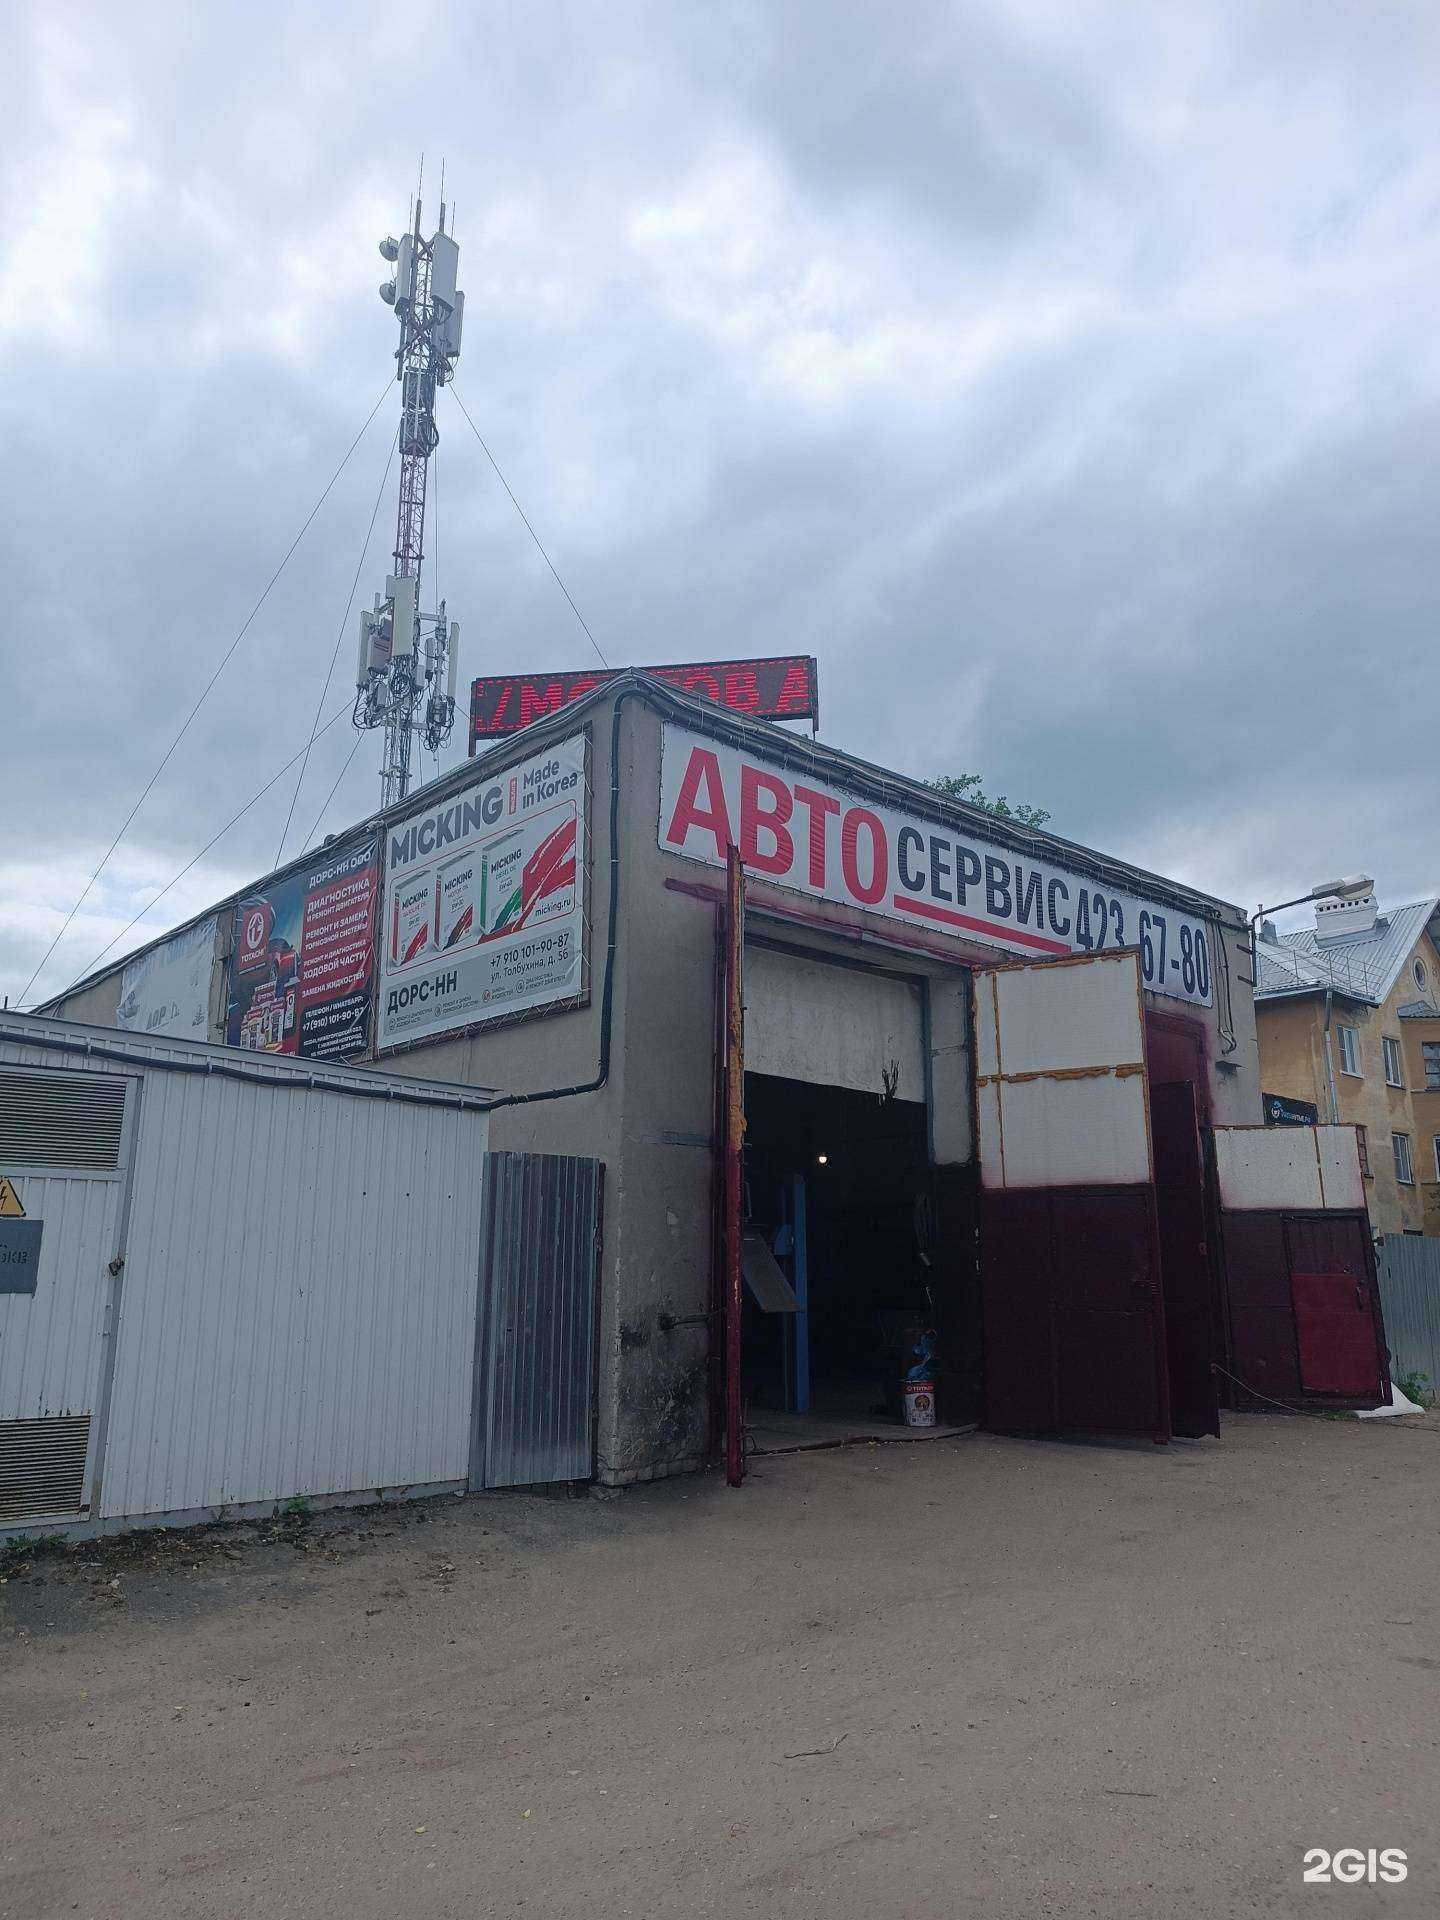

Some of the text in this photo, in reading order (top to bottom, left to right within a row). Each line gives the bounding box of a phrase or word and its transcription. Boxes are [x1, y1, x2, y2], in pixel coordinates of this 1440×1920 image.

[523, 760, 559, 789] Made
[522, 795, 534, 809] in
[537, 772, 577, 803] Korea
[391, 786, 503, 869] MICKING
[309, 861, 349, 889] ДОРС-НН
[491, 849, 522, 873] MICKING
[666, 746, 888, 906] АВТО
[1139, 910, 1209, 997] 67-80
[444, 869, 473, 892] MICKING
[307, 879, 370, 914] ДИАГНОСТИКА
[401, 888, 429, 910] MICKING
[535, 899, 571, 917] micking.ru
[306, 923, 333, 940] РЕМОНТ
[340, 909, 368, 927] ЗАМЕНА
[312, 905, 335, 920] РЕМОНТ
[305, 922, 368, 951] ТОРМОЗНОЙ СИСТЕМЫ
[490, 932, 569, 968] +7 910 101-90-87
[303, 950, 366, 980] ХОДОВОЙ ЧАСТИ
[302, 968, 365, 998] ЗАМЕНА ЖИДКОСТЕЙ
[387, 971, 458, 1015] ДОРС-НН
[305, 1006, 330, 1018] ТЕЛЕФОН
[329, 1007, 364, 1024] 101-90-87
